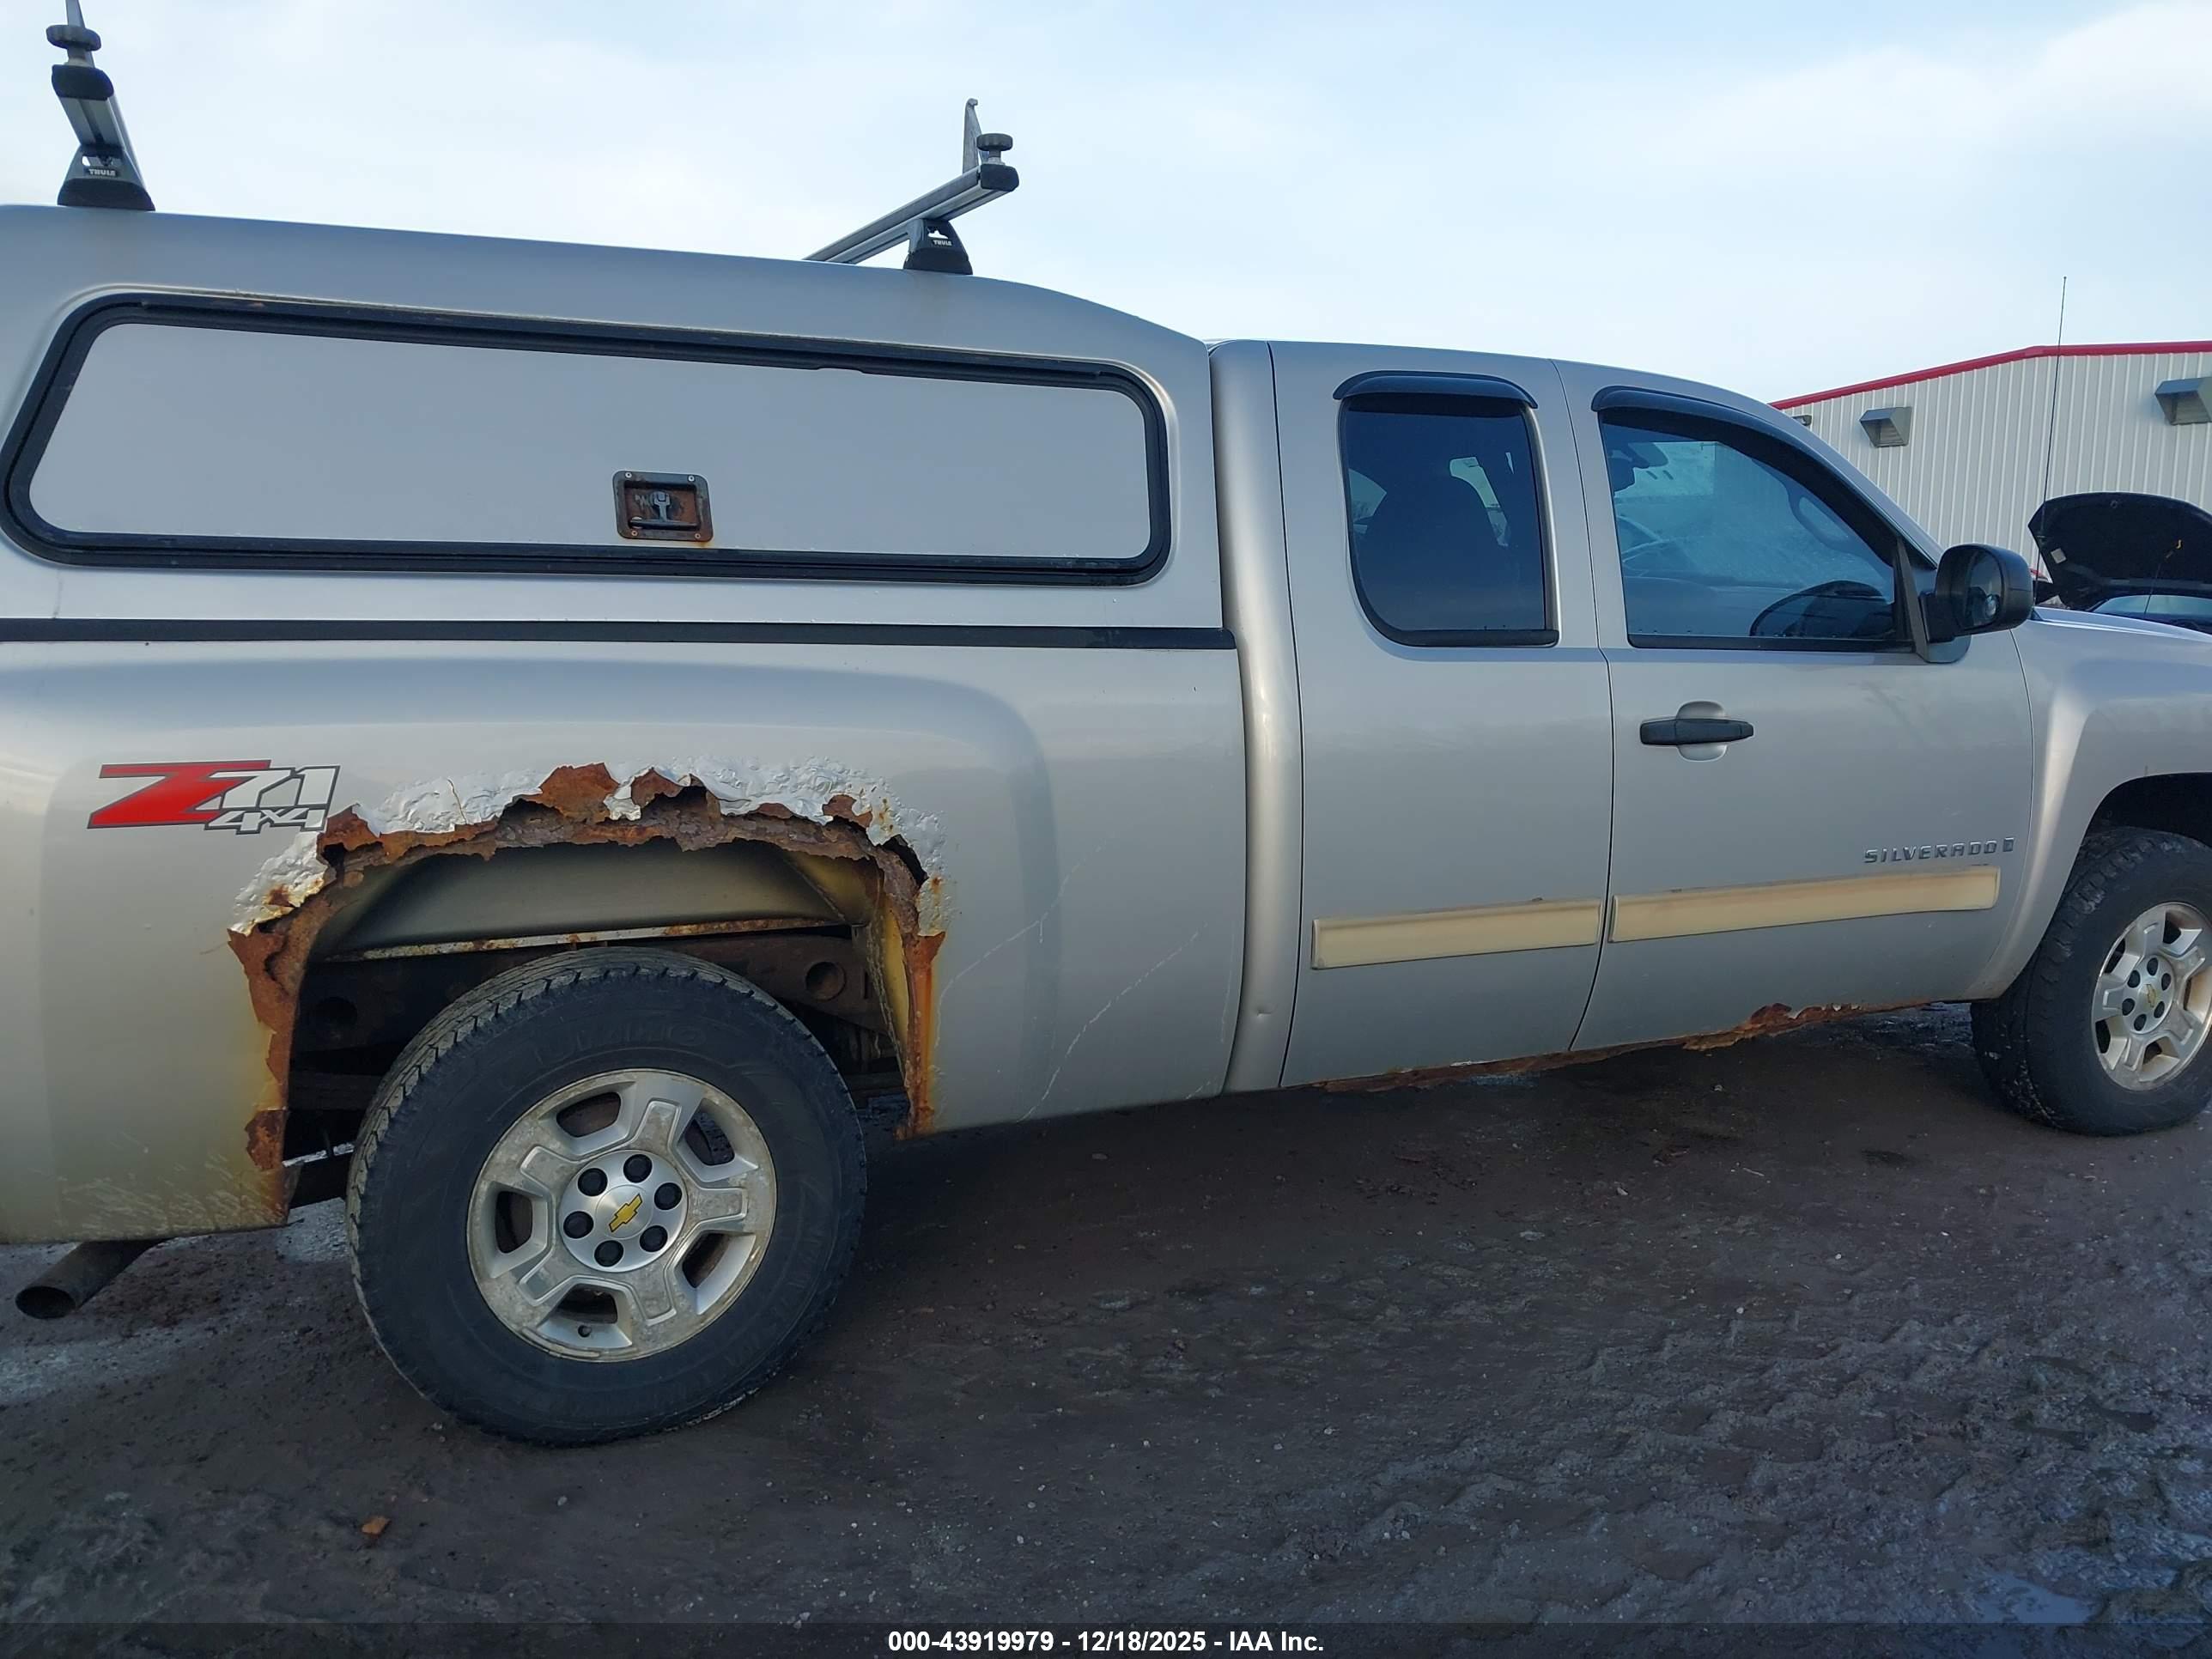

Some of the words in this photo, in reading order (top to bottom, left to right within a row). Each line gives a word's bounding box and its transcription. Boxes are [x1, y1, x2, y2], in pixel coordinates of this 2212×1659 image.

[88, 168, 116, 177] THULE
[88, 759, 340, 829] Z71
[1863, 840, 1998, 864] SILVERADO
